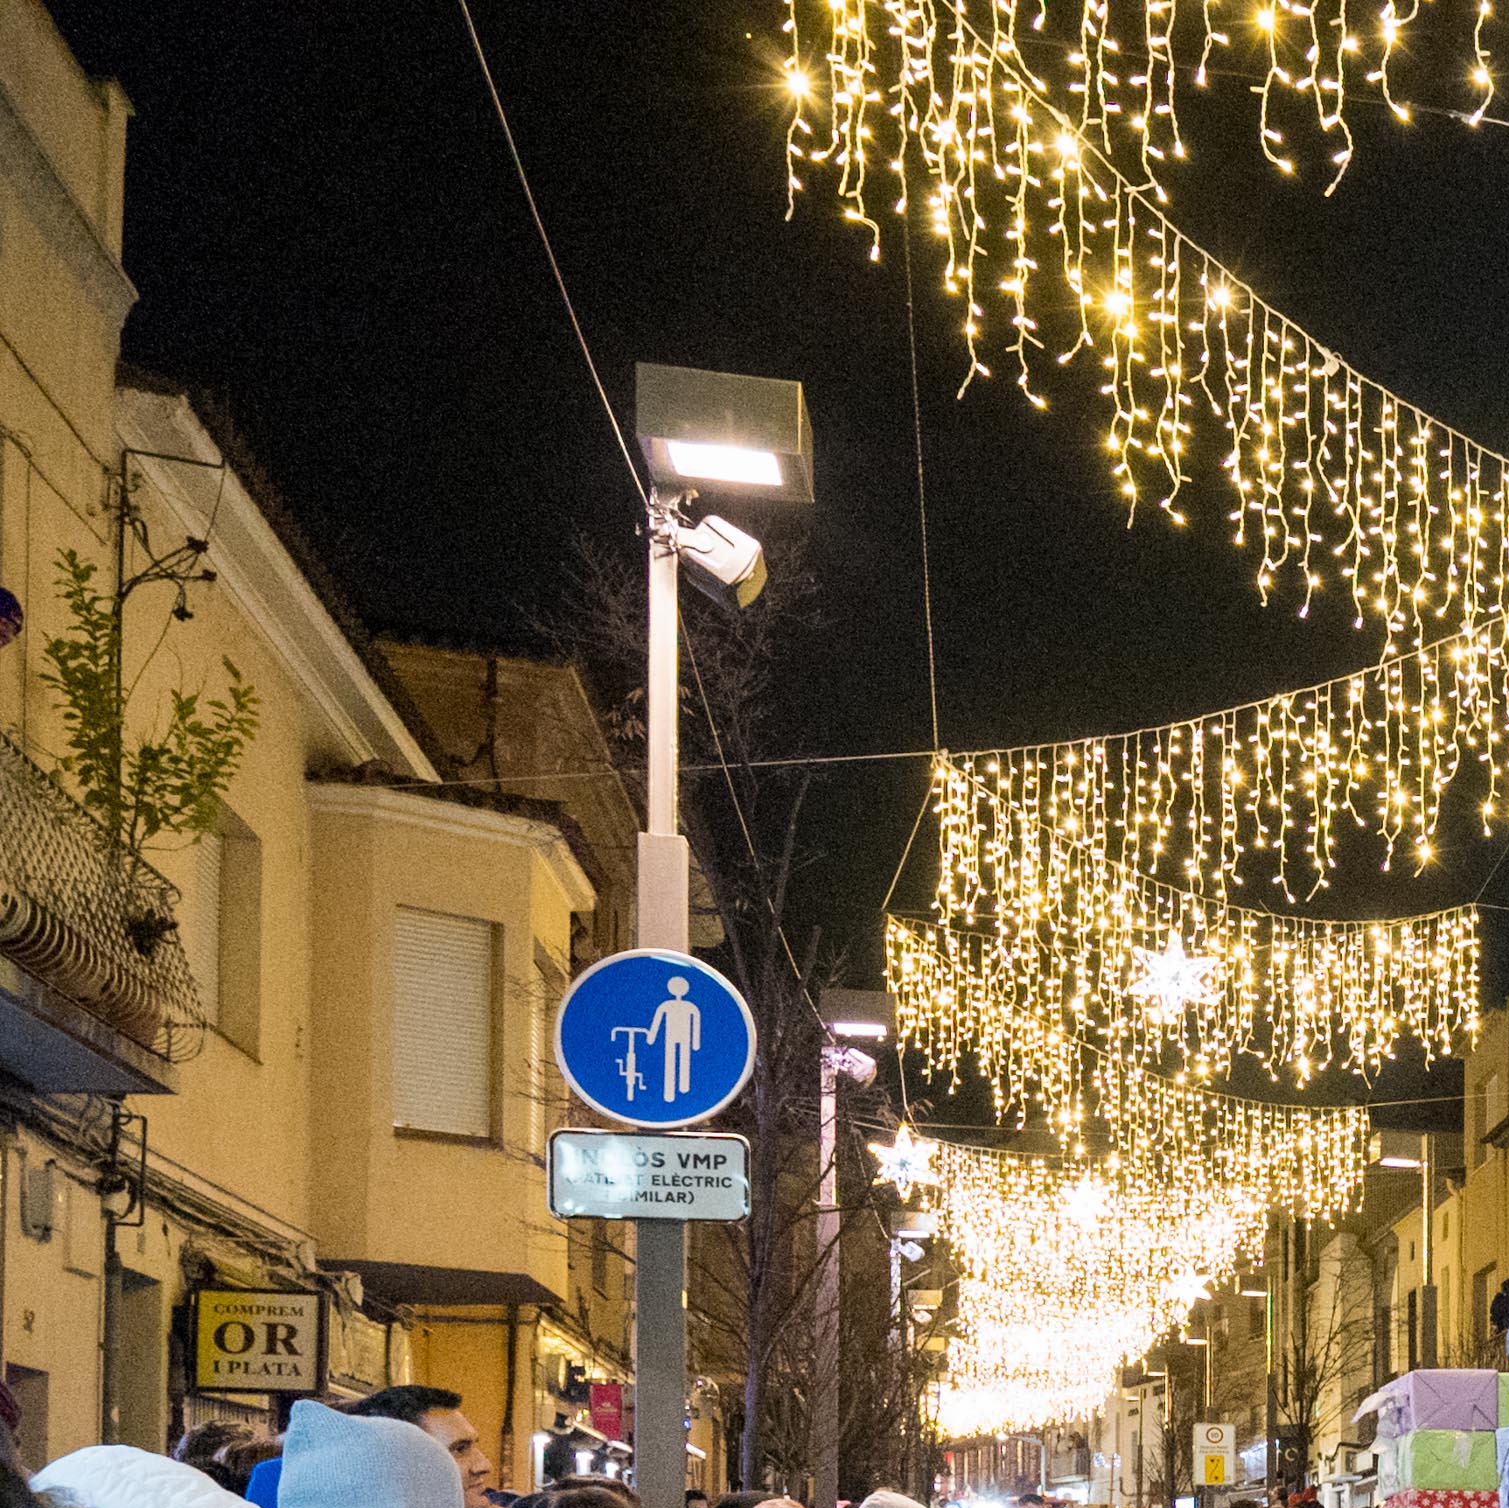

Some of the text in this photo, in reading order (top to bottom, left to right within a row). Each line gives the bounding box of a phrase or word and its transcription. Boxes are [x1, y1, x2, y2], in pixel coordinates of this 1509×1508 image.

[677, 1152, 728, 1170] VMP
[651, 1172, 732, 1188] ELÈCTRIC
[213, 1303, 304, 1317] COMPREM
[212, 1320, 303, 1357] OR
[213, 1360, 303, 1377] I PLATA
